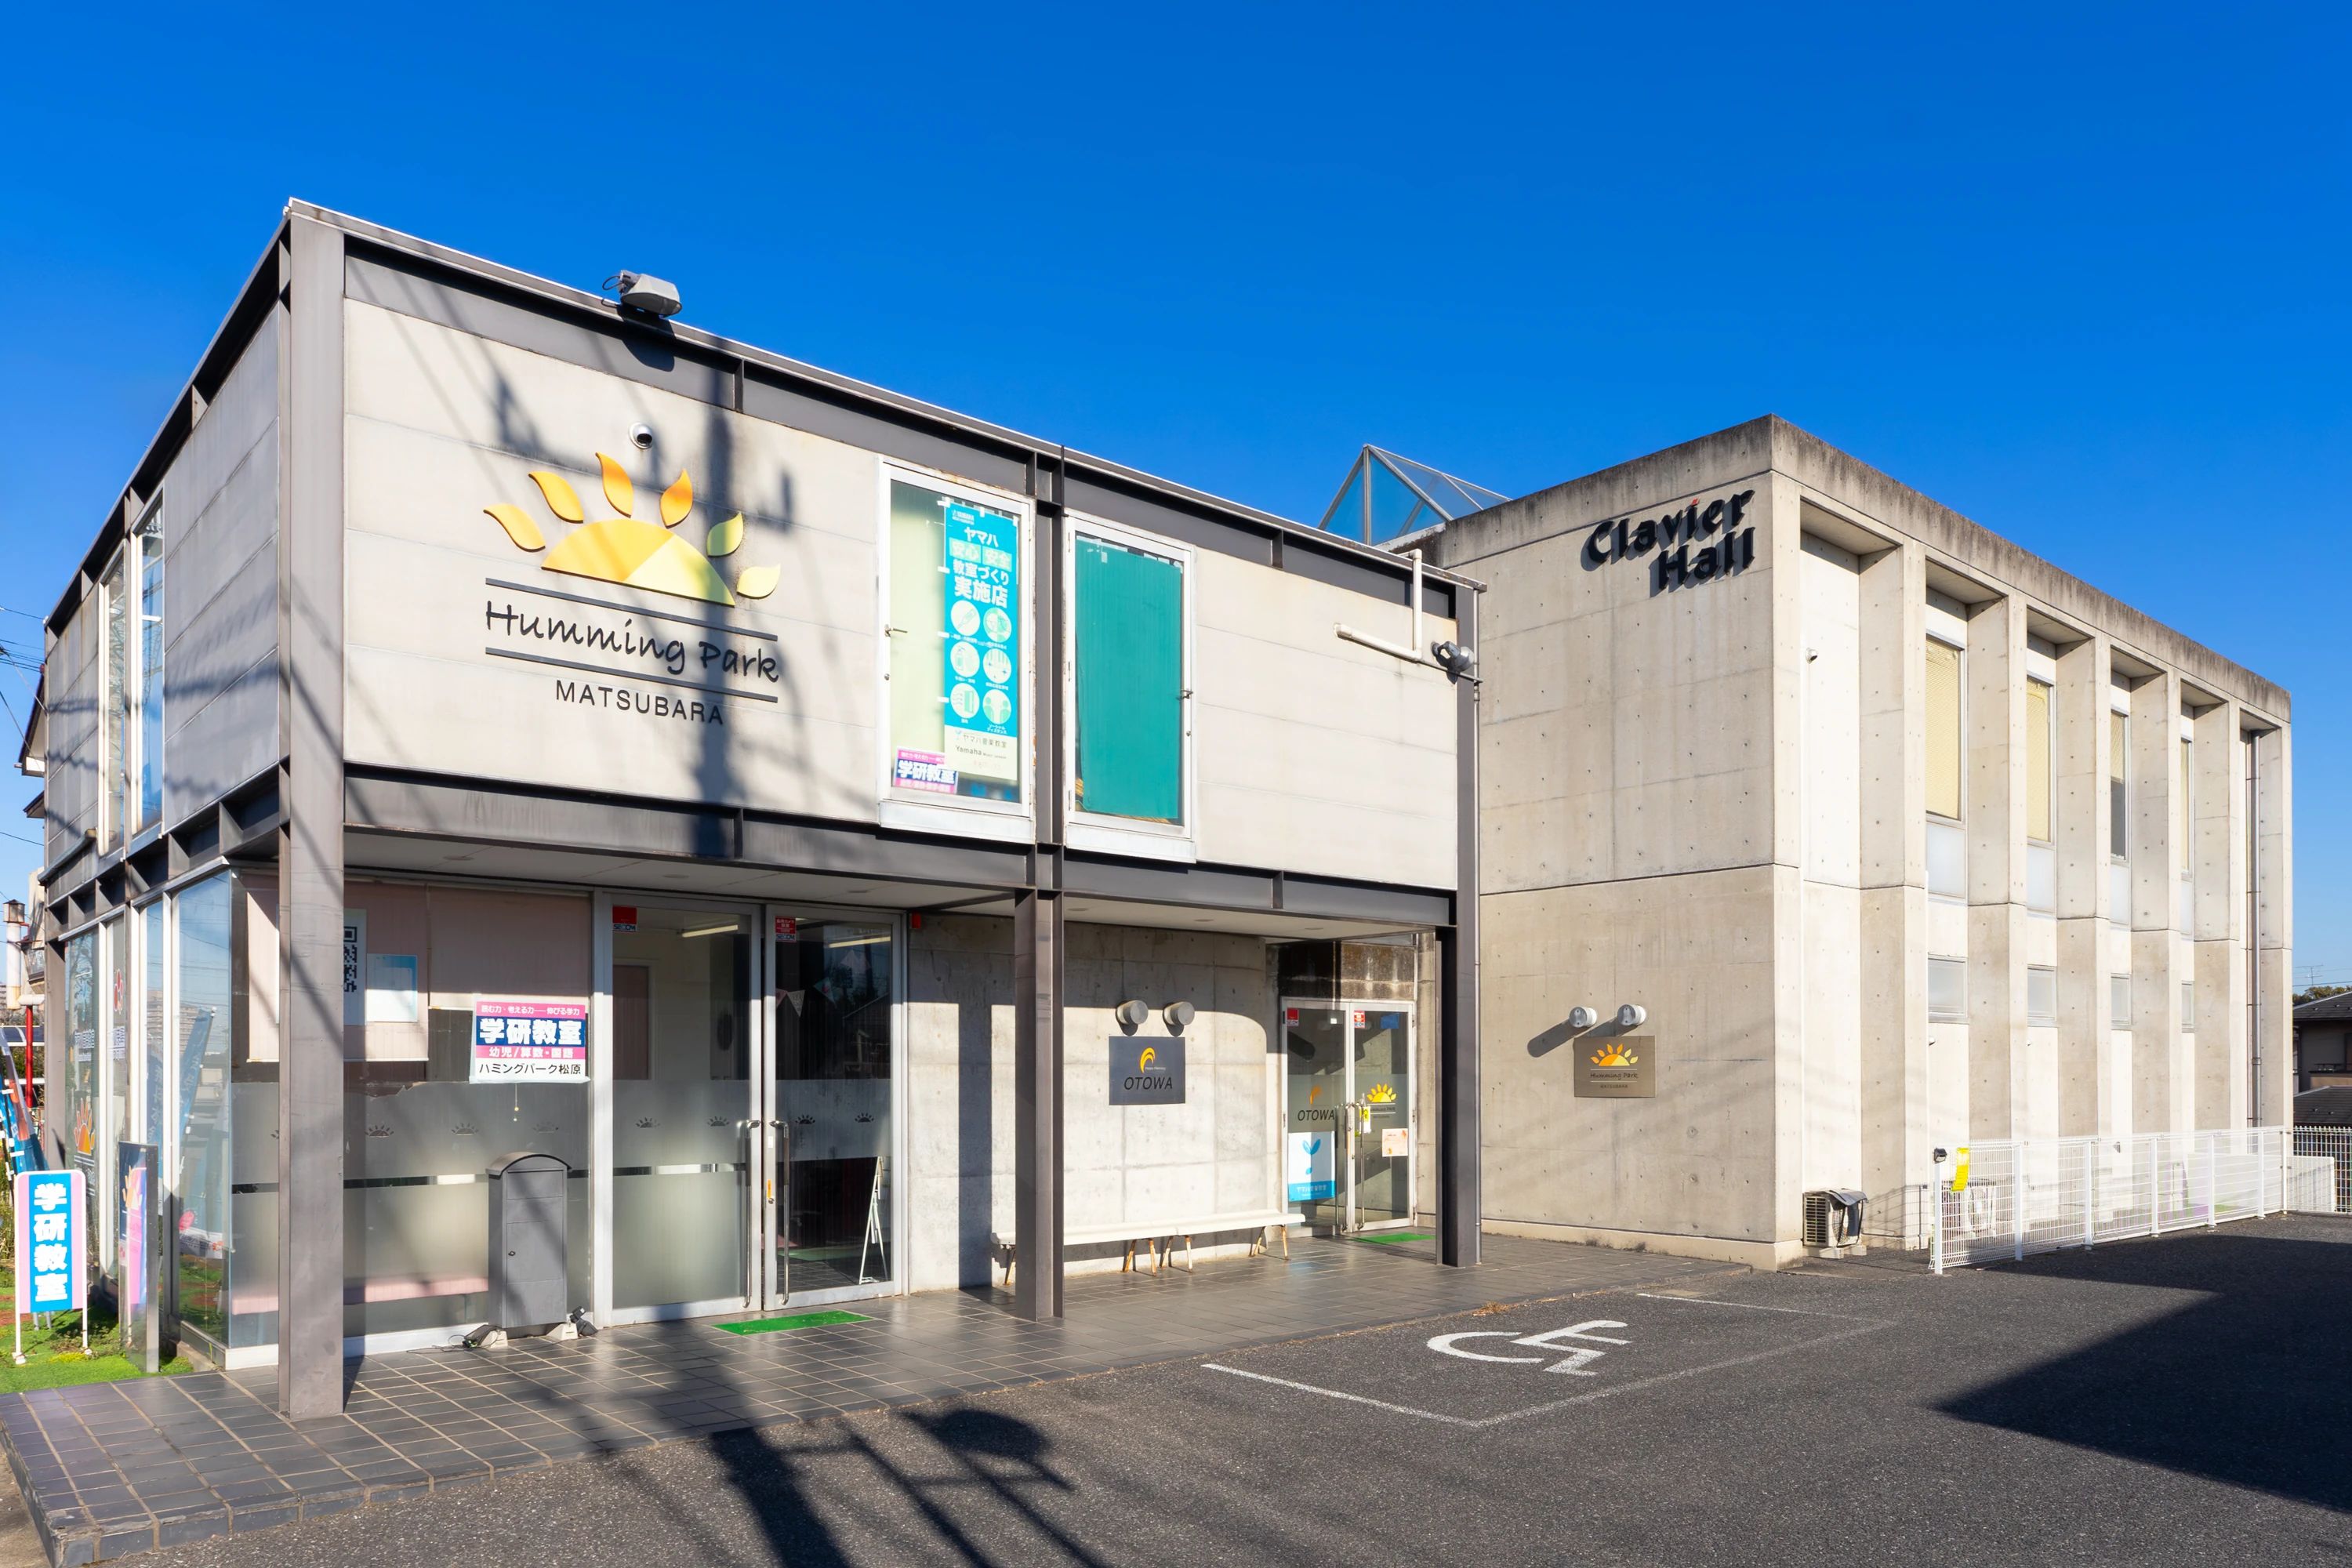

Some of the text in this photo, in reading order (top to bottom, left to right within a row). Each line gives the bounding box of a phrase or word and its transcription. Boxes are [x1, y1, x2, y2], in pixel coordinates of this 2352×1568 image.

[964, 526, 1000, 548] ヤマハ
[1587, 489, 1755, 564] Clavier
[953, 558, 1009, 586] 教室づくり
[1656, 526, 1755, 592] Hall
[954, 575, 1008, 608] 実施店
[485, 600, 779, 683] Humming Park
[555, 679, 724, 726] MATSUBARA
[956, 745, 982, 756] Yamaha
[898, 759, 956, 785] 学研教室
[479, 1018, 583, 1045] 学研教室
[479, 1063, 582, 1075] ハミングパーク松原
[1123, 1076, 1173, 1091] OTOWA
[1298, 1109, 1335, 1121] OTOWA
[33, 1182, 68, 1302] 学研教室
